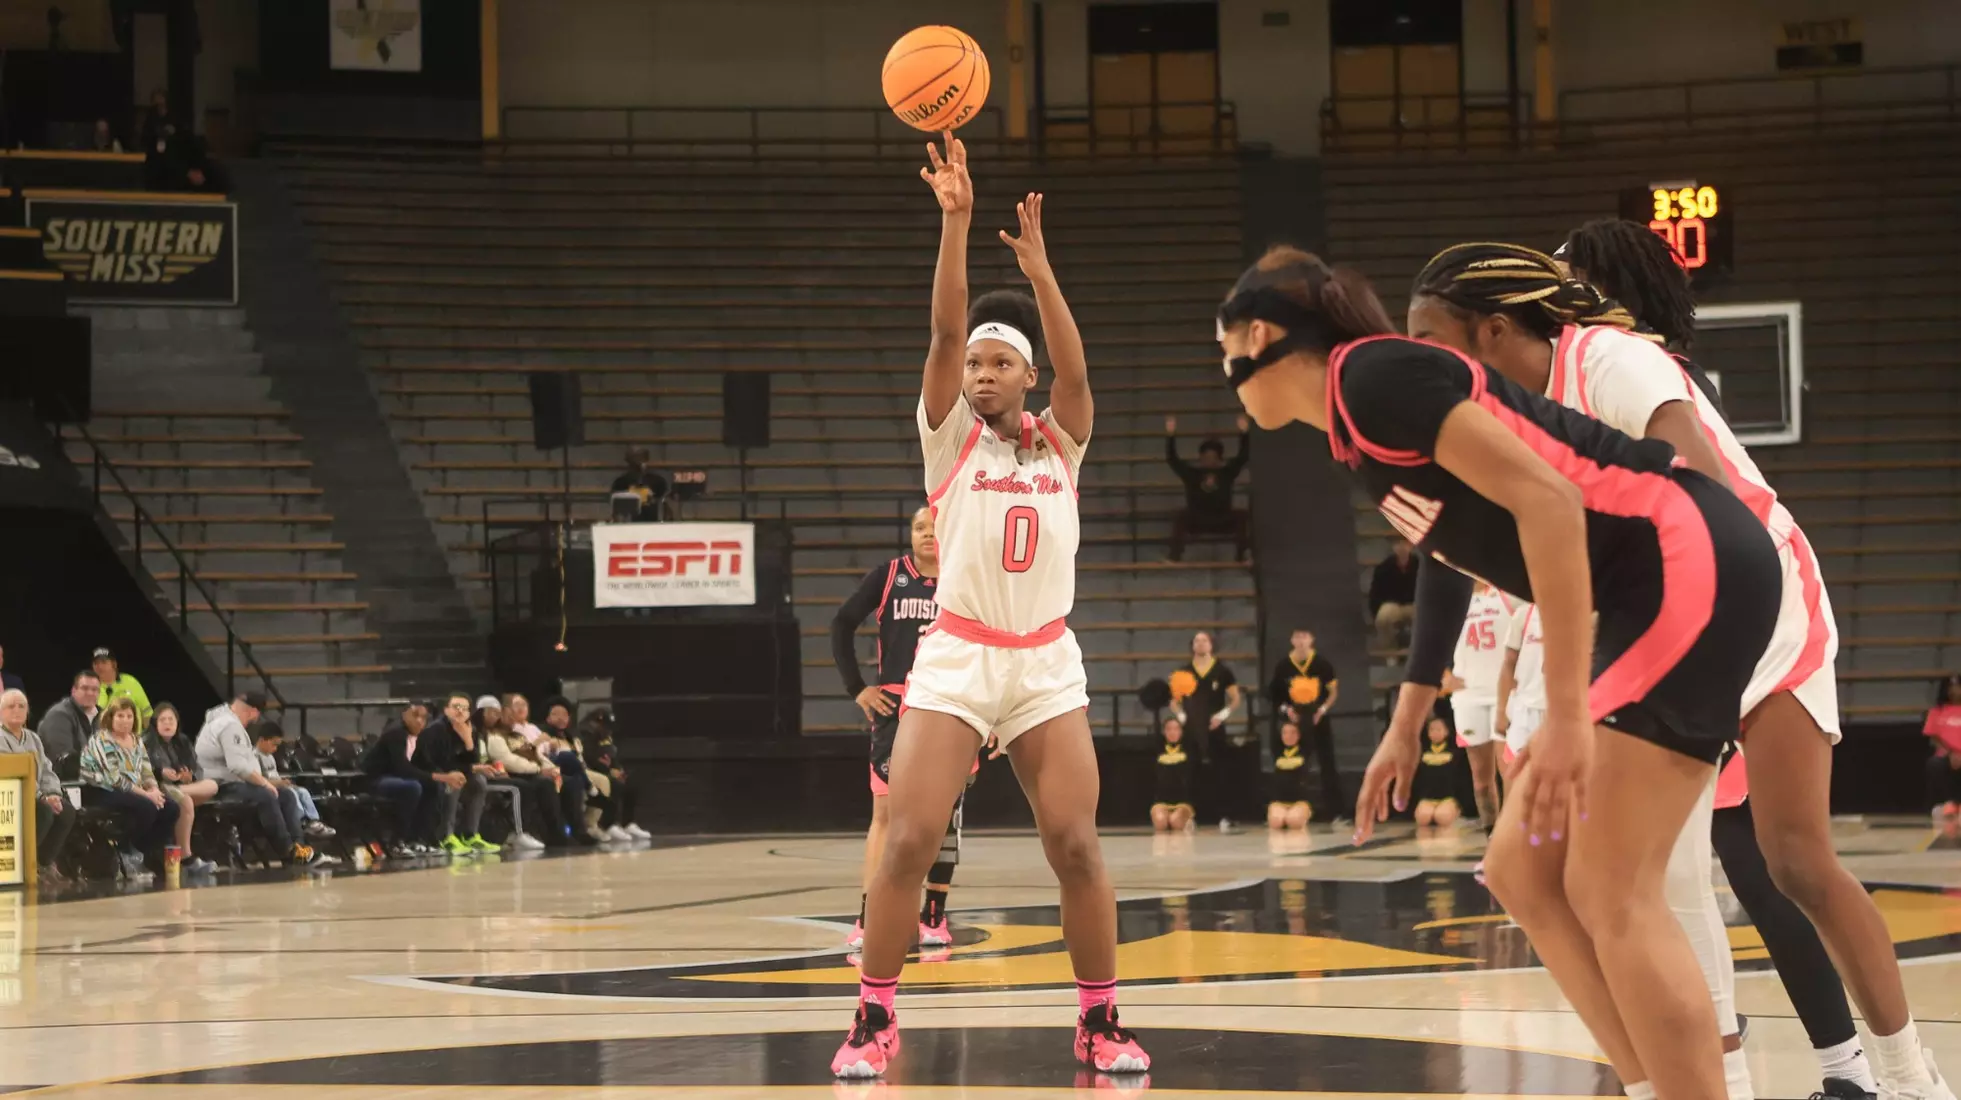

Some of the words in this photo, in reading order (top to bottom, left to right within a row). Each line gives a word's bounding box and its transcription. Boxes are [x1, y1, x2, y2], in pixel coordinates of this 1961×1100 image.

[900, 84, 960, 122] Wilson
[1654, 186, 1718, 221] 3:50
[43, 219, 224, 255] SOUTHERN
[91, 253, 163, 283] MISS
[971, 470, 1033, 494] Southern
[1002, 506, 1039, 573] 0
[608, 541, 742, 577] ESPN
[893, 598, 938, 620] LOUISI
[1466, 620, 1496, 651] 45
